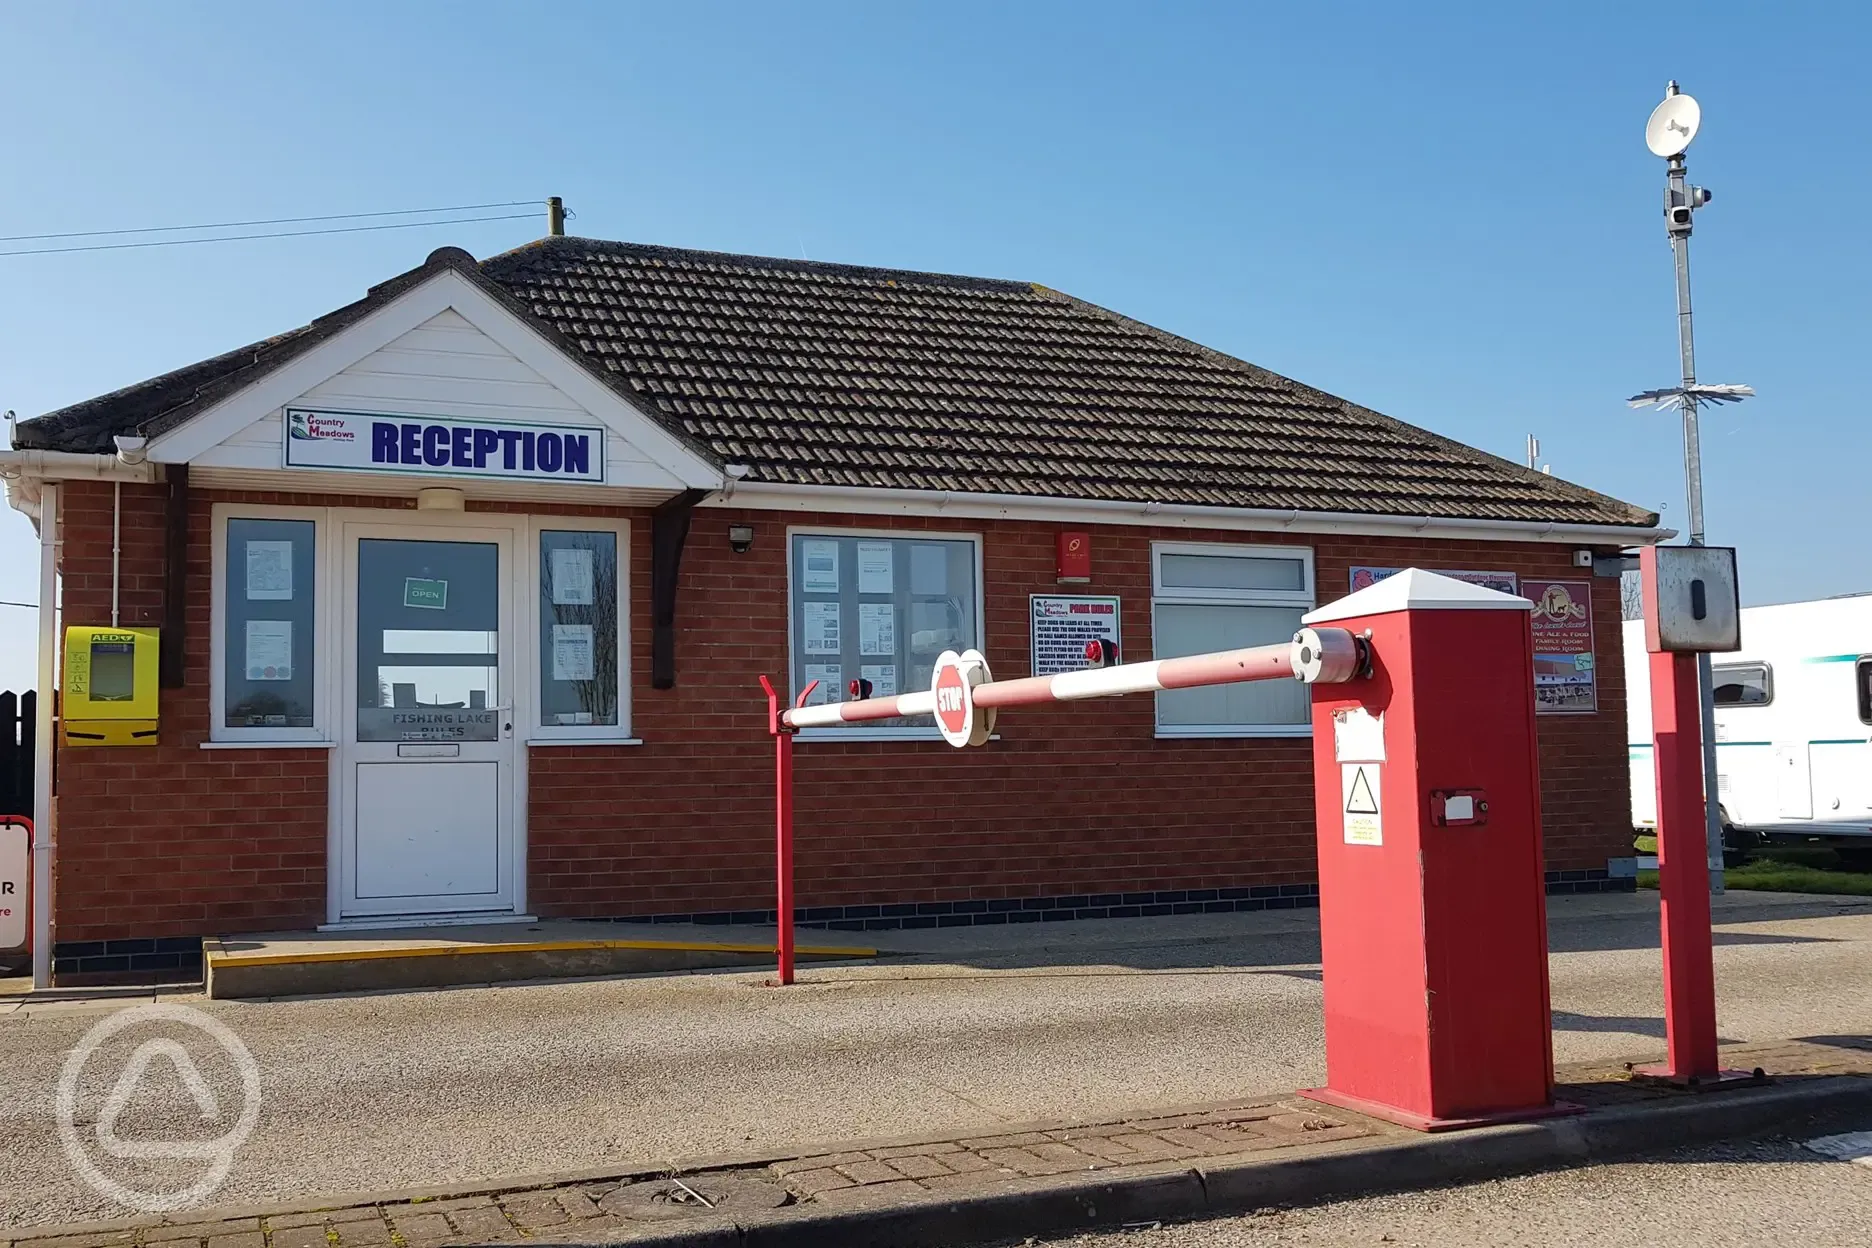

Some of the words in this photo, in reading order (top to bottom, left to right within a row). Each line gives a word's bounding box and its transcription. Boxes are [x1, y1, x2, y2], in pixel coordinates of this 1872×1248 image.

[307, 414, 345, 428] Country
[309, 426, 354, 439] Meadows
[372, 422, 589, 474] RECEPTION
[1374, 570, 1393, 580] Hard
[412, 590, 440, 599] OPEN
[1043, 600, 1063, 609] Country
[1045, 607, 1068, 615] Meadows
[938, 686, 963, 712] STOP
[393, 714, 453, 724] FISHING
[458, 714, 493, 724] LAKE
